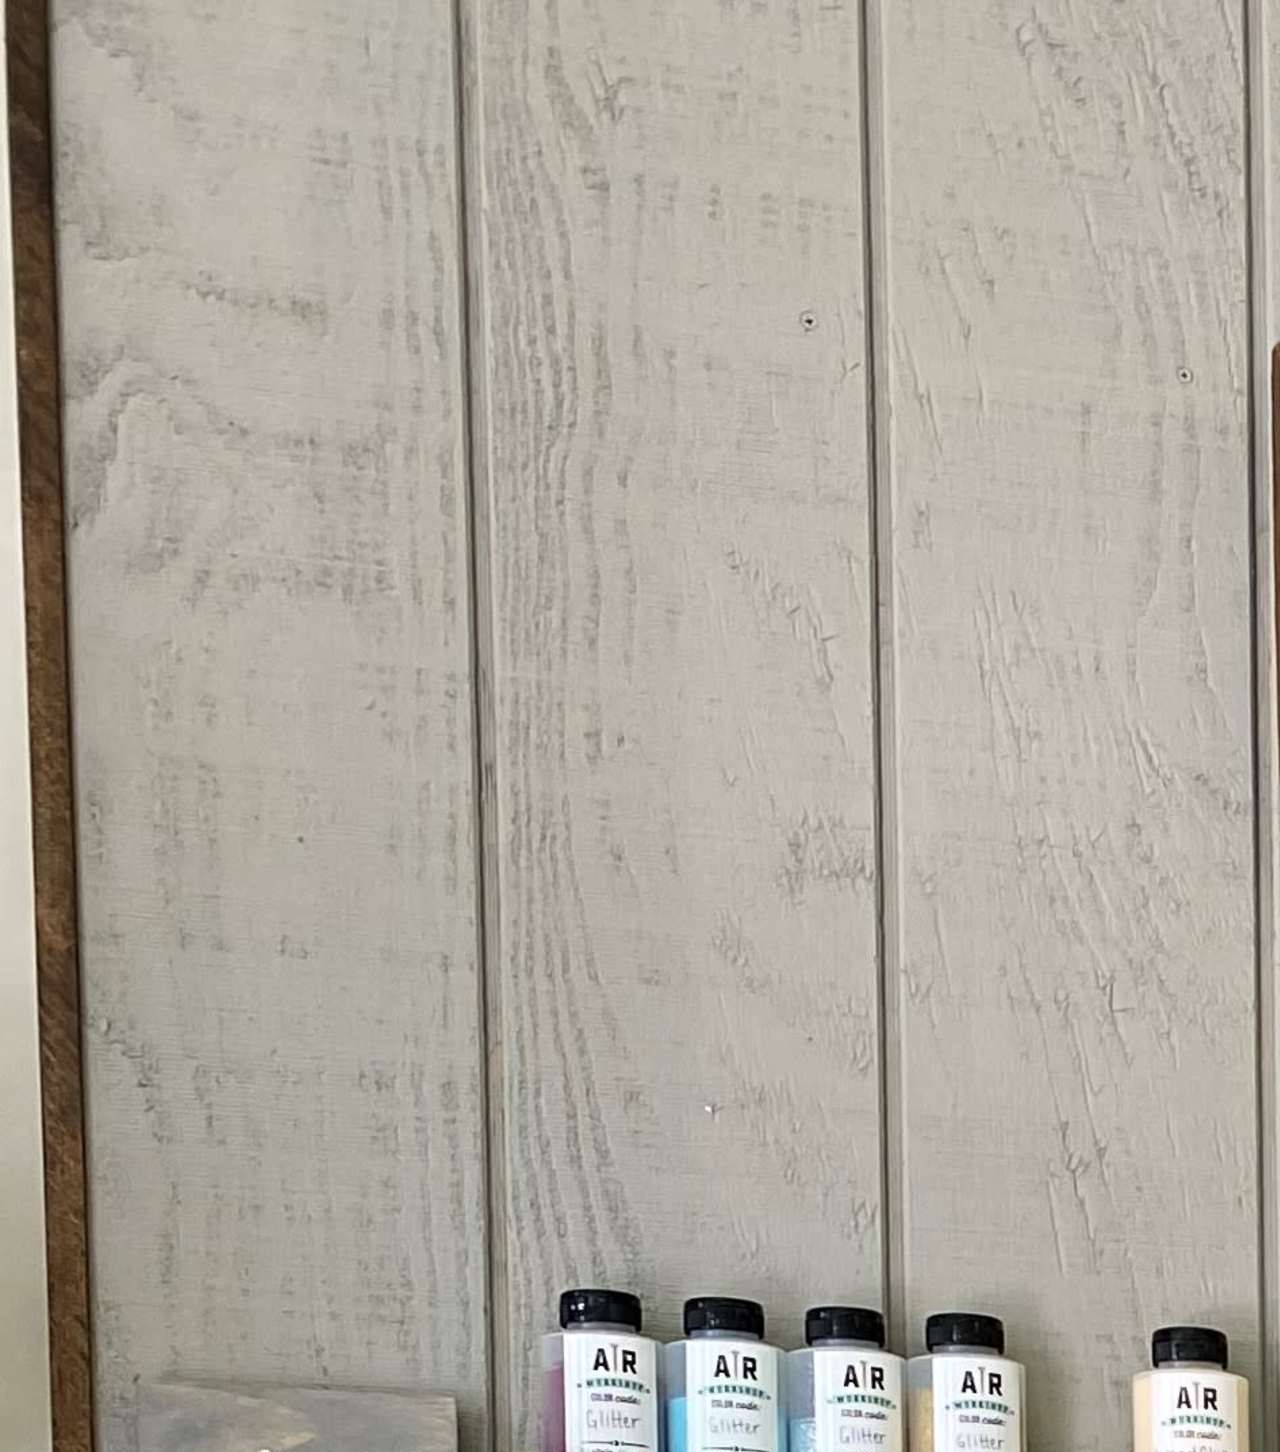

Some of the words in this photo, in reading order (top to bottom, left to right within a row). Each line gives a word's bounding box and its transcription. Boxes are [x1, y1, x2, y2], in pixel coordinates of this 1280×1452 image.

[585, 1410, 639, 1430] Glitter
[709, 1418, 760, 1435] Glitter
[840, 1426, 886, 1444] Glitter
[957, 1433, 1004, 1450] Glitter
